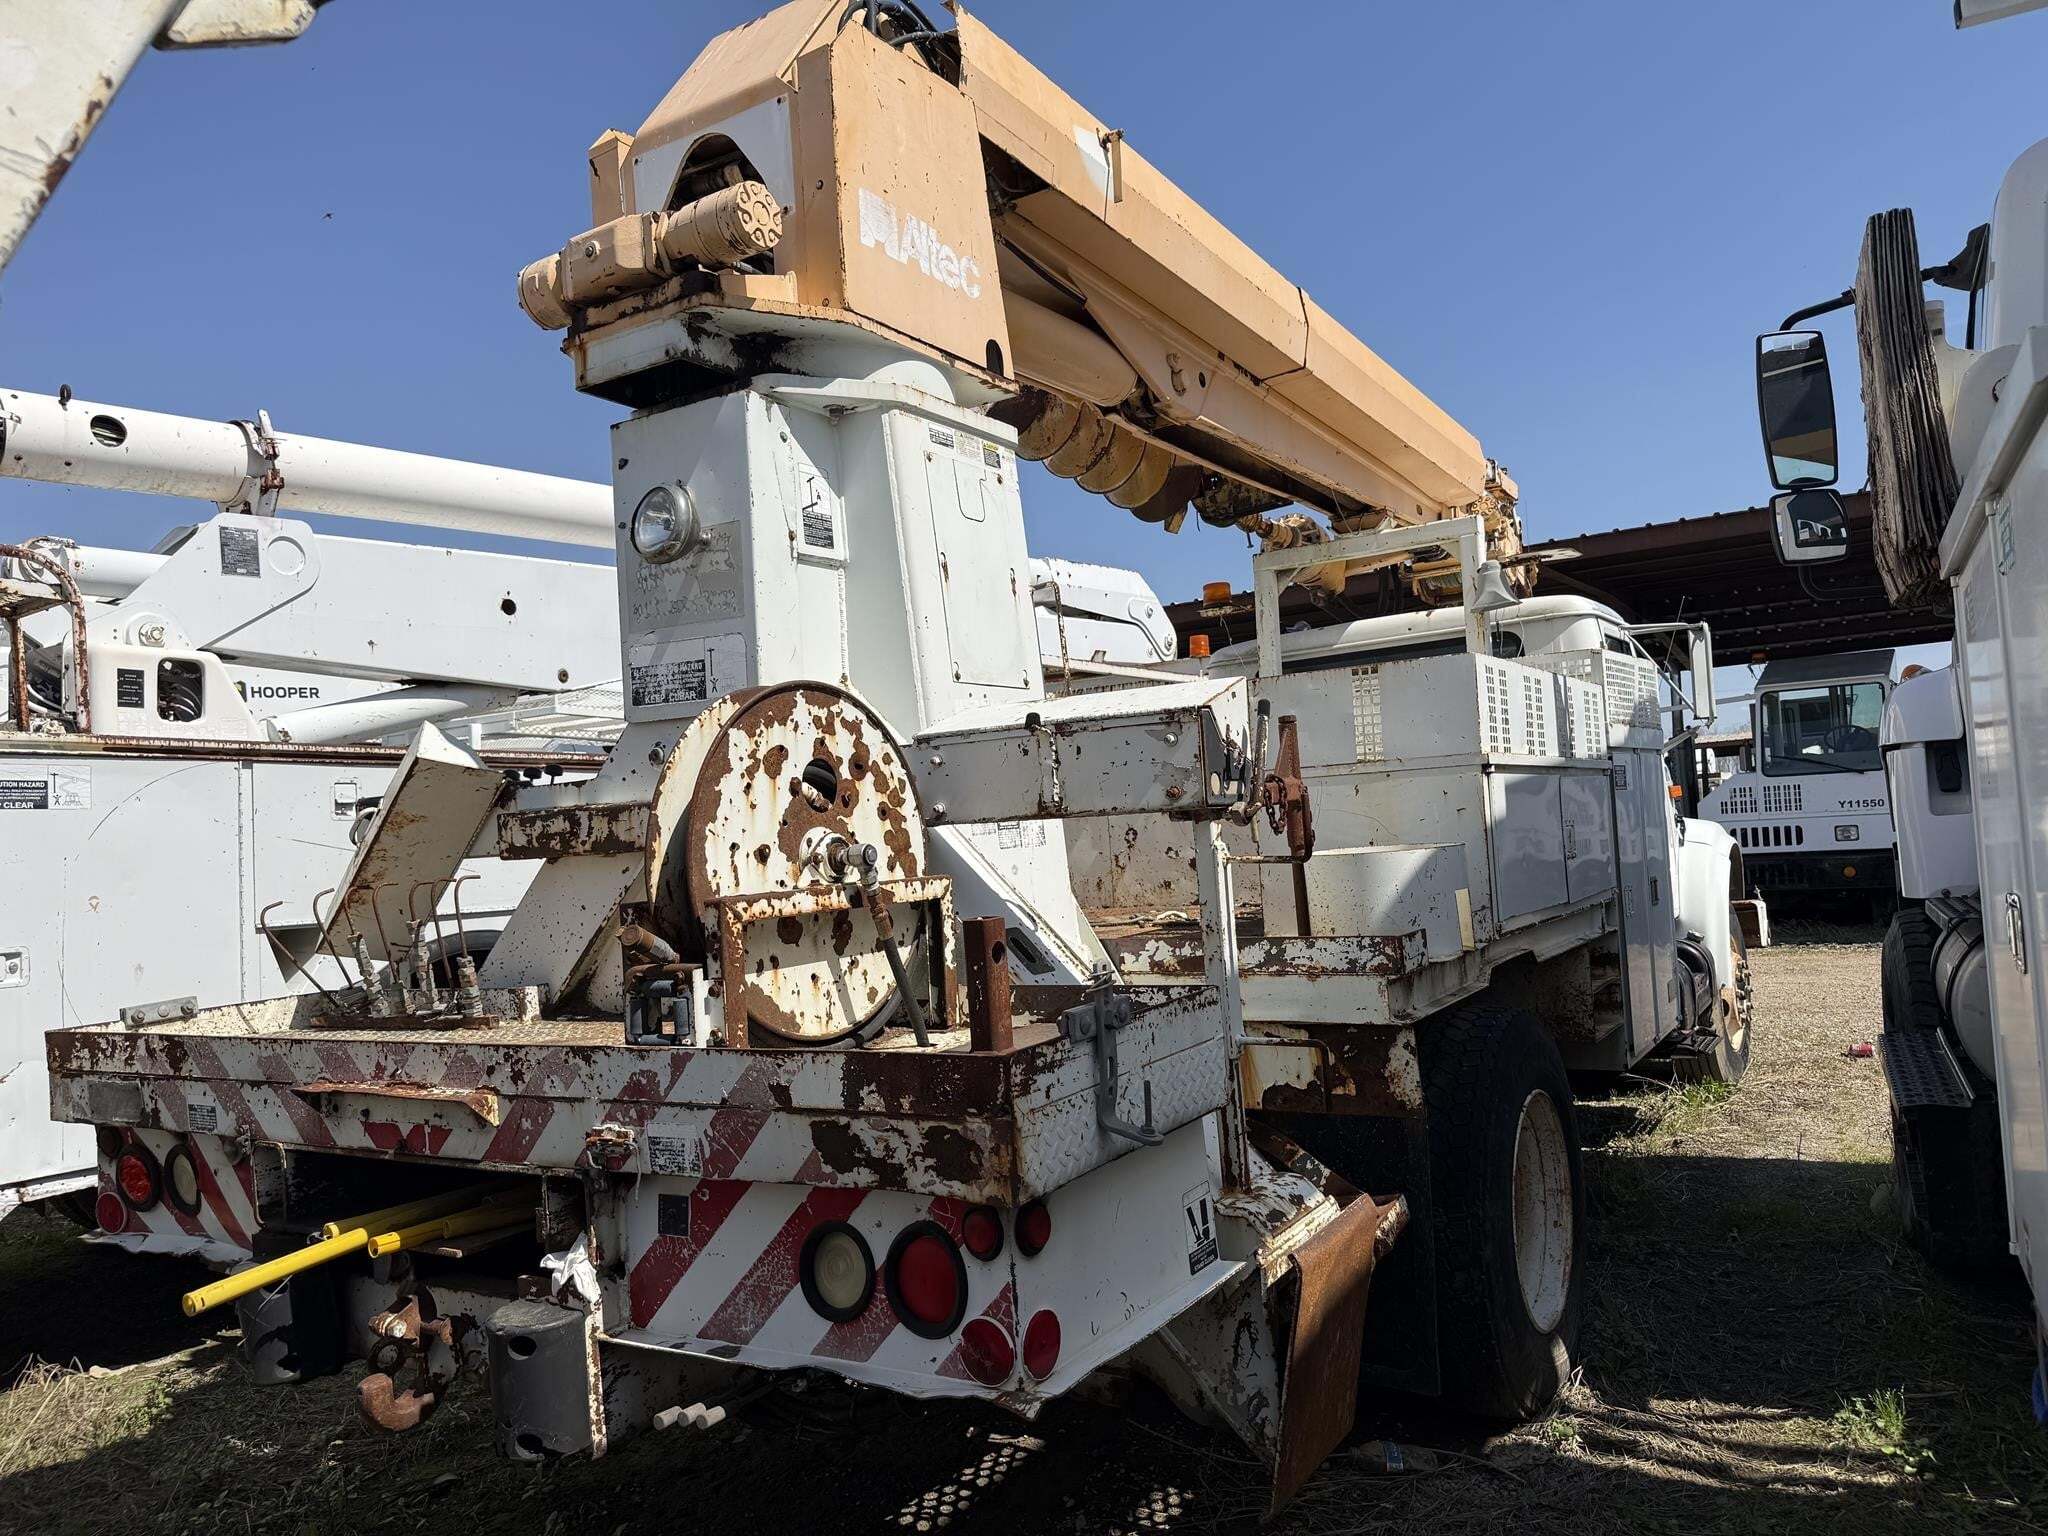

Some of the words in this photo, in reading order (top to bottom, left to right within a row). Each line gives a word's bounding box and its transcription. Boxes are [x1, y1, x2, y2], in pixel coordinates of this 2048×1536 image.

[250, 686, 320, 699] HOOPER
[3, 801, 34, 809] CLEAR
[1838, 799, 1885, 808] Y11550
